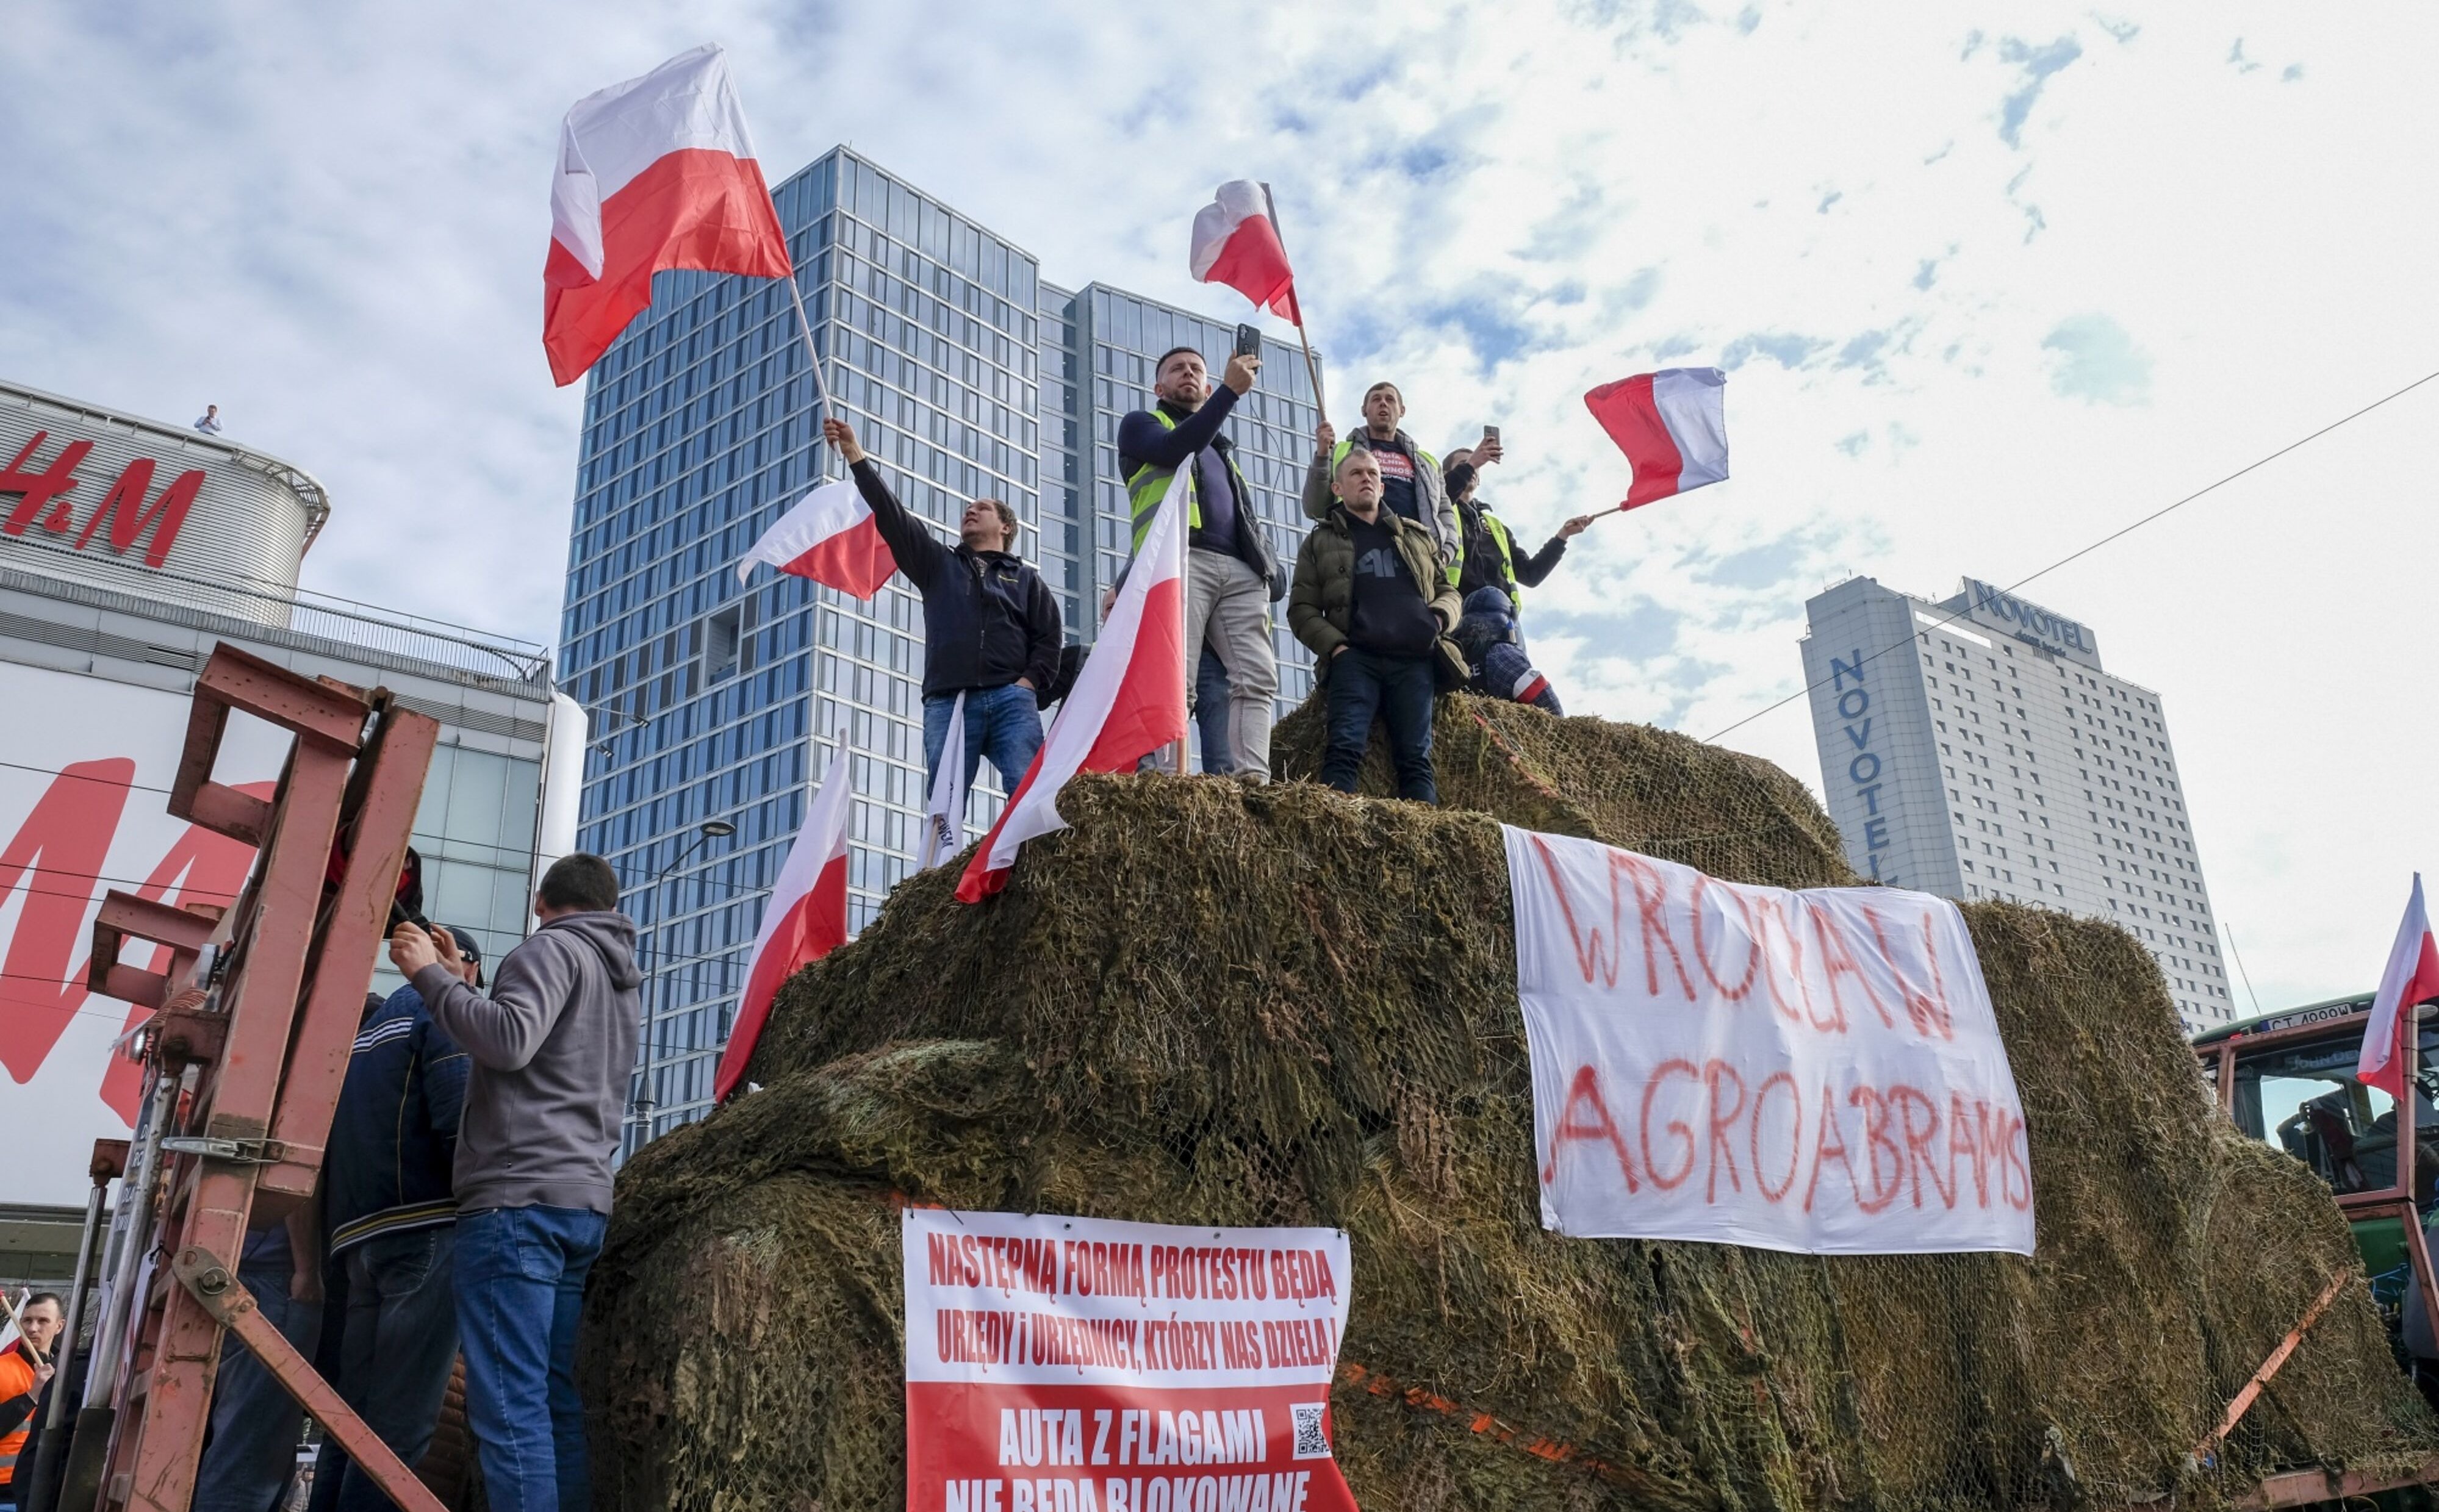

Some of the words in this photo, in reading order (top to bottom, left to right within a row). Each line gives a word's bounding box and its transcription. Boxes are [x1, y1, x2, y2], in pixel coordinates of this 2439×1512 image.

[0, 430, 206, 568] H&M
[1974, 580, 2092, 654] NOVOTEL
[1543, 1058, 2030, 1214] AGROABRAMS
[927, 1232, 1057, 1304] NASTĘPNĄ
[1063, 1240, 1146, 1308] FORMĄ
[1151, 1244, 1267, 1300] PROTESTU
[1270, 1249, 1337, 1308] BĘDĄ
[937, 1309, 1015, 1374] URZĘDY
[1018, 1312, 1026, 1364] i
[1032, 1313, 1142, 1376] URZĘDNICY,
[1144, 1311, 1217, 1371] KTÓRZY
[1220, 1320, 1263, 1370] NAS
[999, 1408, 1084, 1467] AUTA
[1091, 1409, 1113, 1465] Z
[1119, 1409, 1266, 1466] FLAGAMI
[946, 1478, 1003, 1512] NIE
